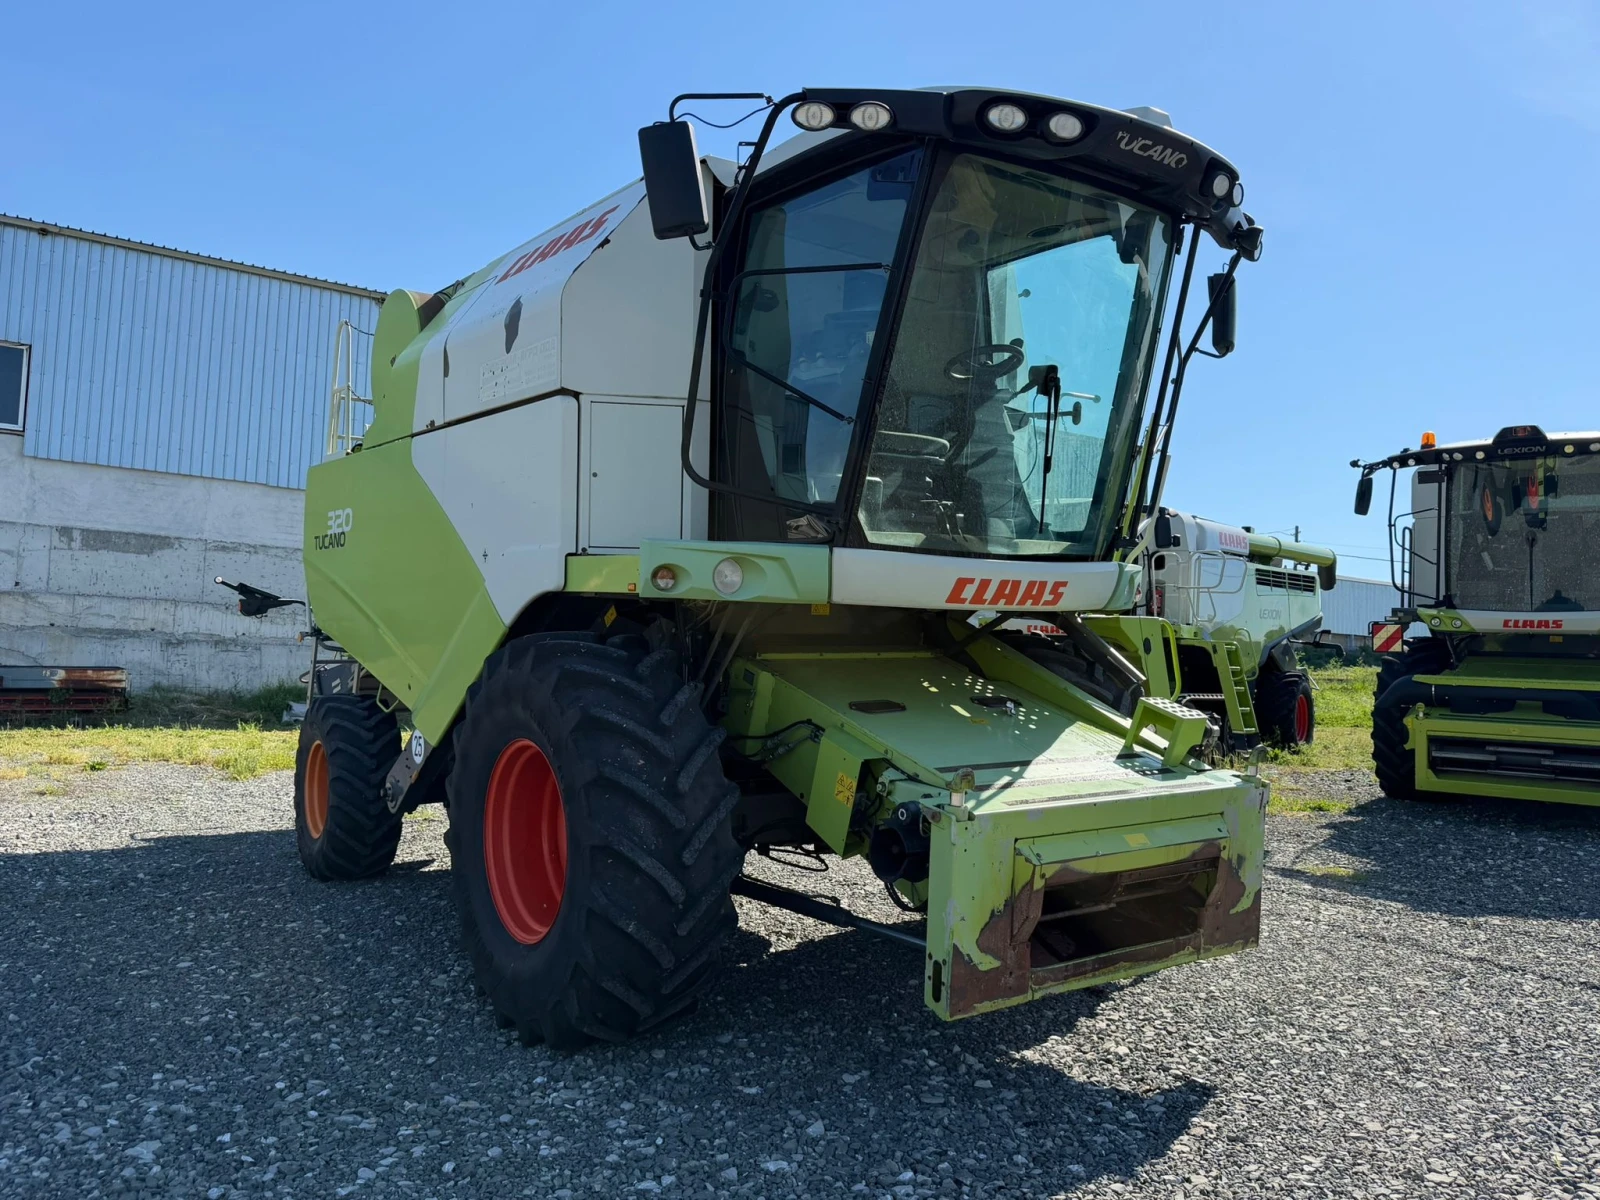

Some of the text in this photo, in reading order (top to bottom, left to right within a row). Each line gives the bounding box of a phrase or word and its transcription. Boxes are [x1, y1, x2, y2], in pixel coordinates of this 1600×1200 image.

[494, 203, 621, 285] CLAAS
[1497, 445, 1546, 455] LEXION
[328, 508, 352, 534] 320
[314, 532, 346, 550] TUCANO
[1218, 532, 1248, 550] CLAAS
[945, 577, 1068, 606] CLAAS
[1503, 619, 1563, 629] CLAAS
[414, 736, 422, 757] 25
